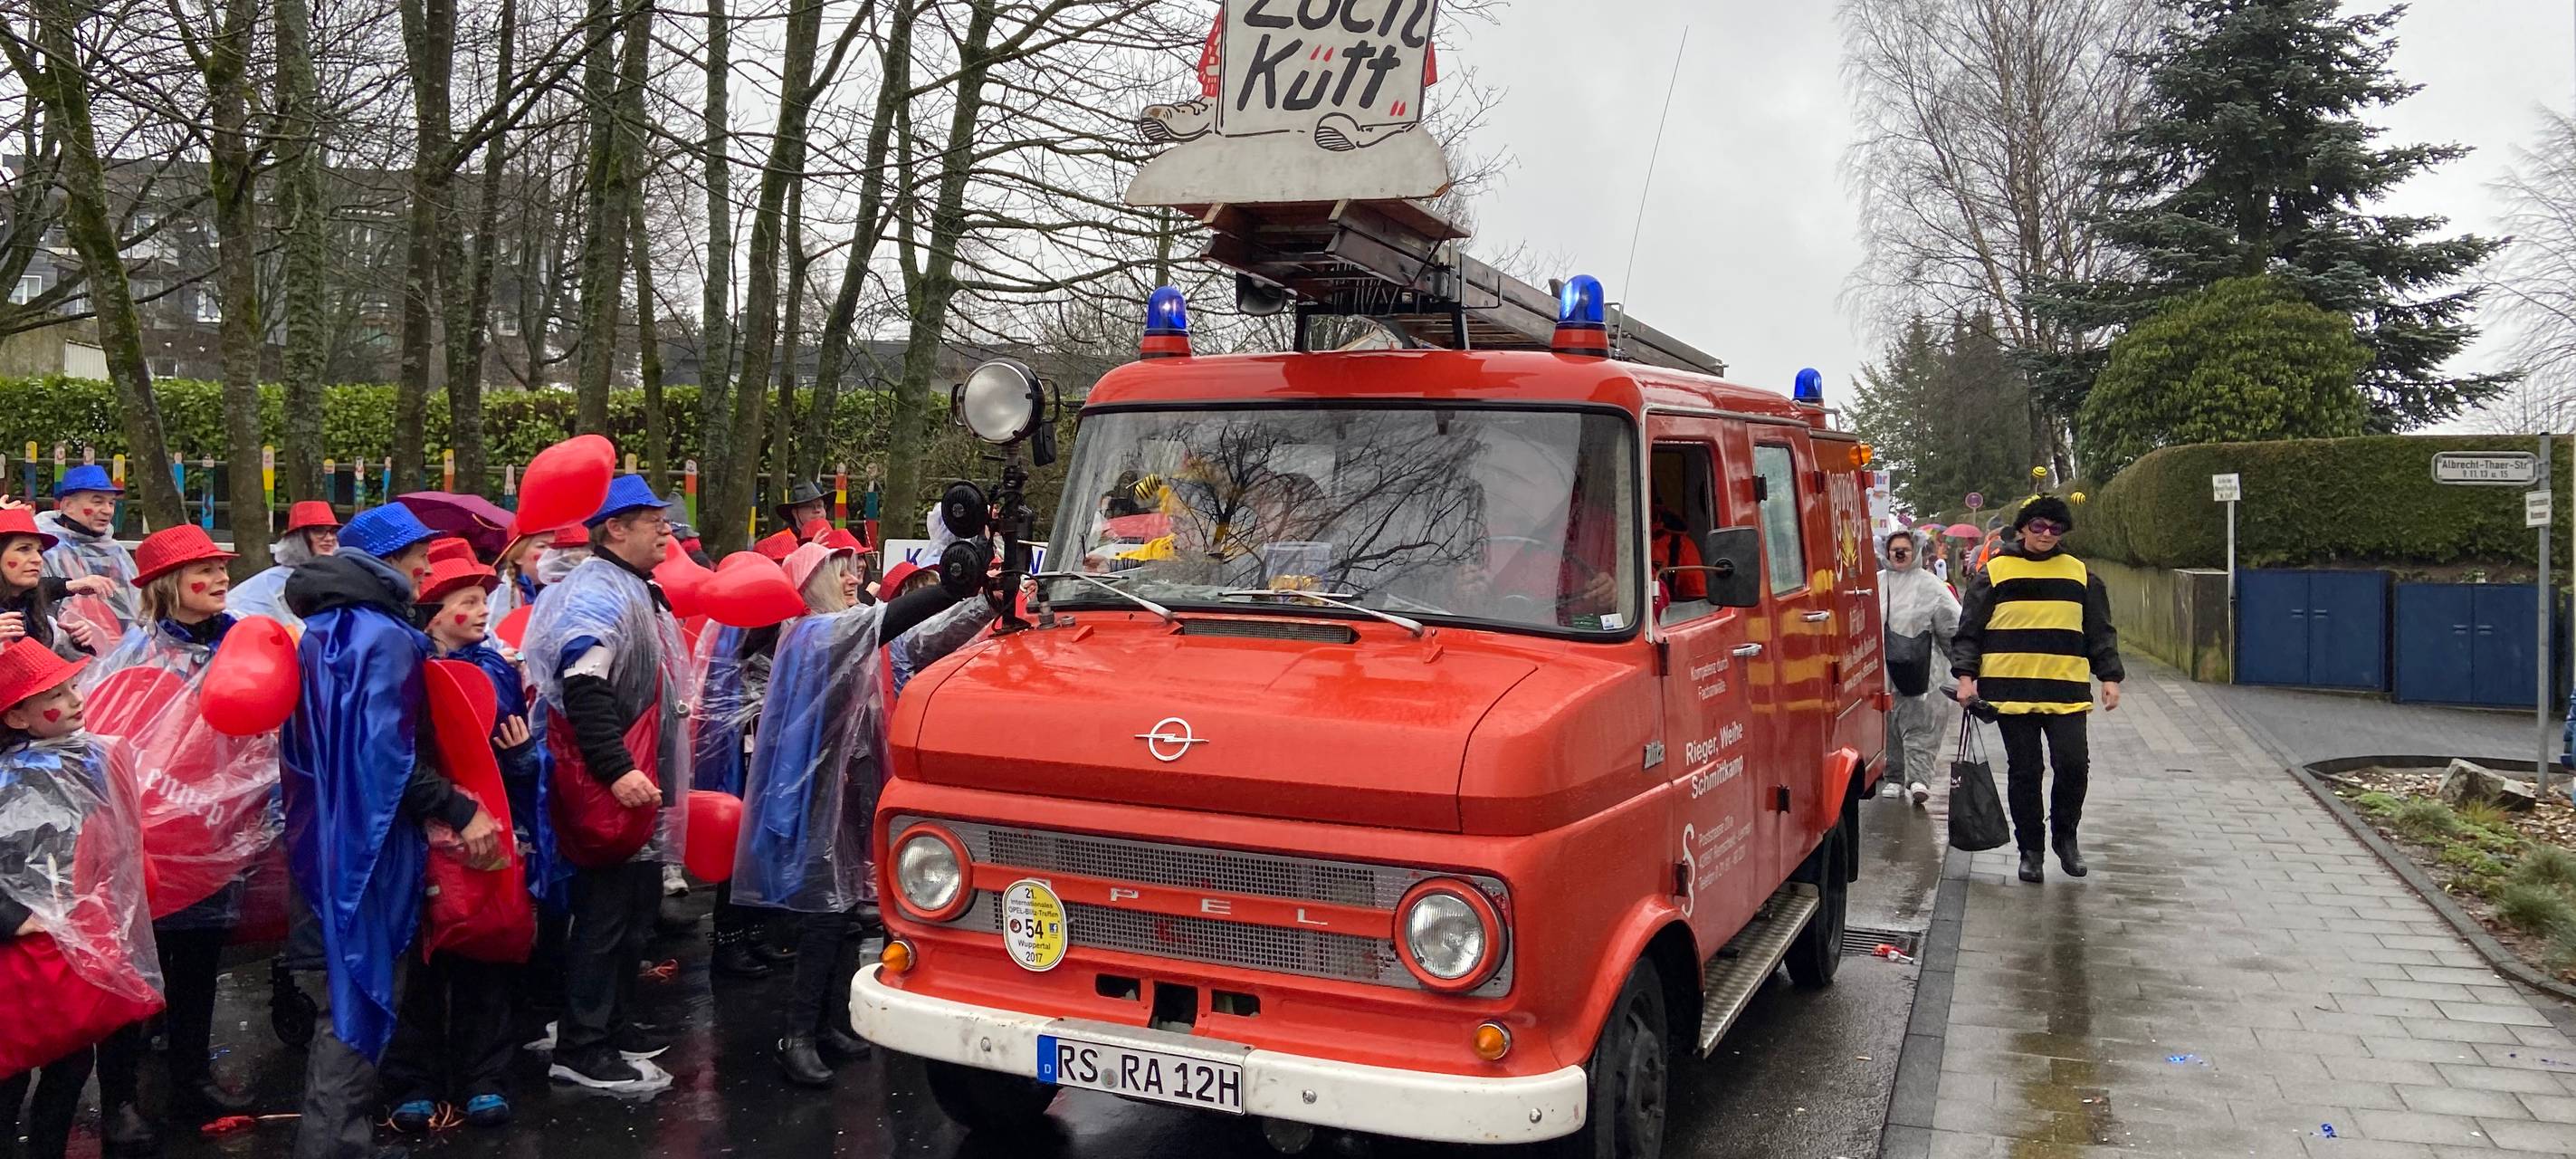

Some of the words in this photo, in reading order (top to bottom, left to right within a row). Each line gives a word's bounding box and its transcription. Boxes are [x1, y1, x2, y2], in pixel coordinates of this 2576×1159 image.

[1686, 737, 1719, 766] Rieger,
[1720, 721, 1743, 749] Weihe
[1692, 754, 1744, 799] Schmittkamp
[1025, 887, 1037, 899] 21.
[1025, 918, 1044, 939] 54
[1017, 939, 1051, 950] Wuppertal
[1026, 951, 1044, 963] 2017
[1044, 1063, 1052, 1074] D
[1057, 1044, 1099, 1083] RS
[1121, 1054, 1164, 1095] RA
[1174, 1062, 1239, 1107] 12H
